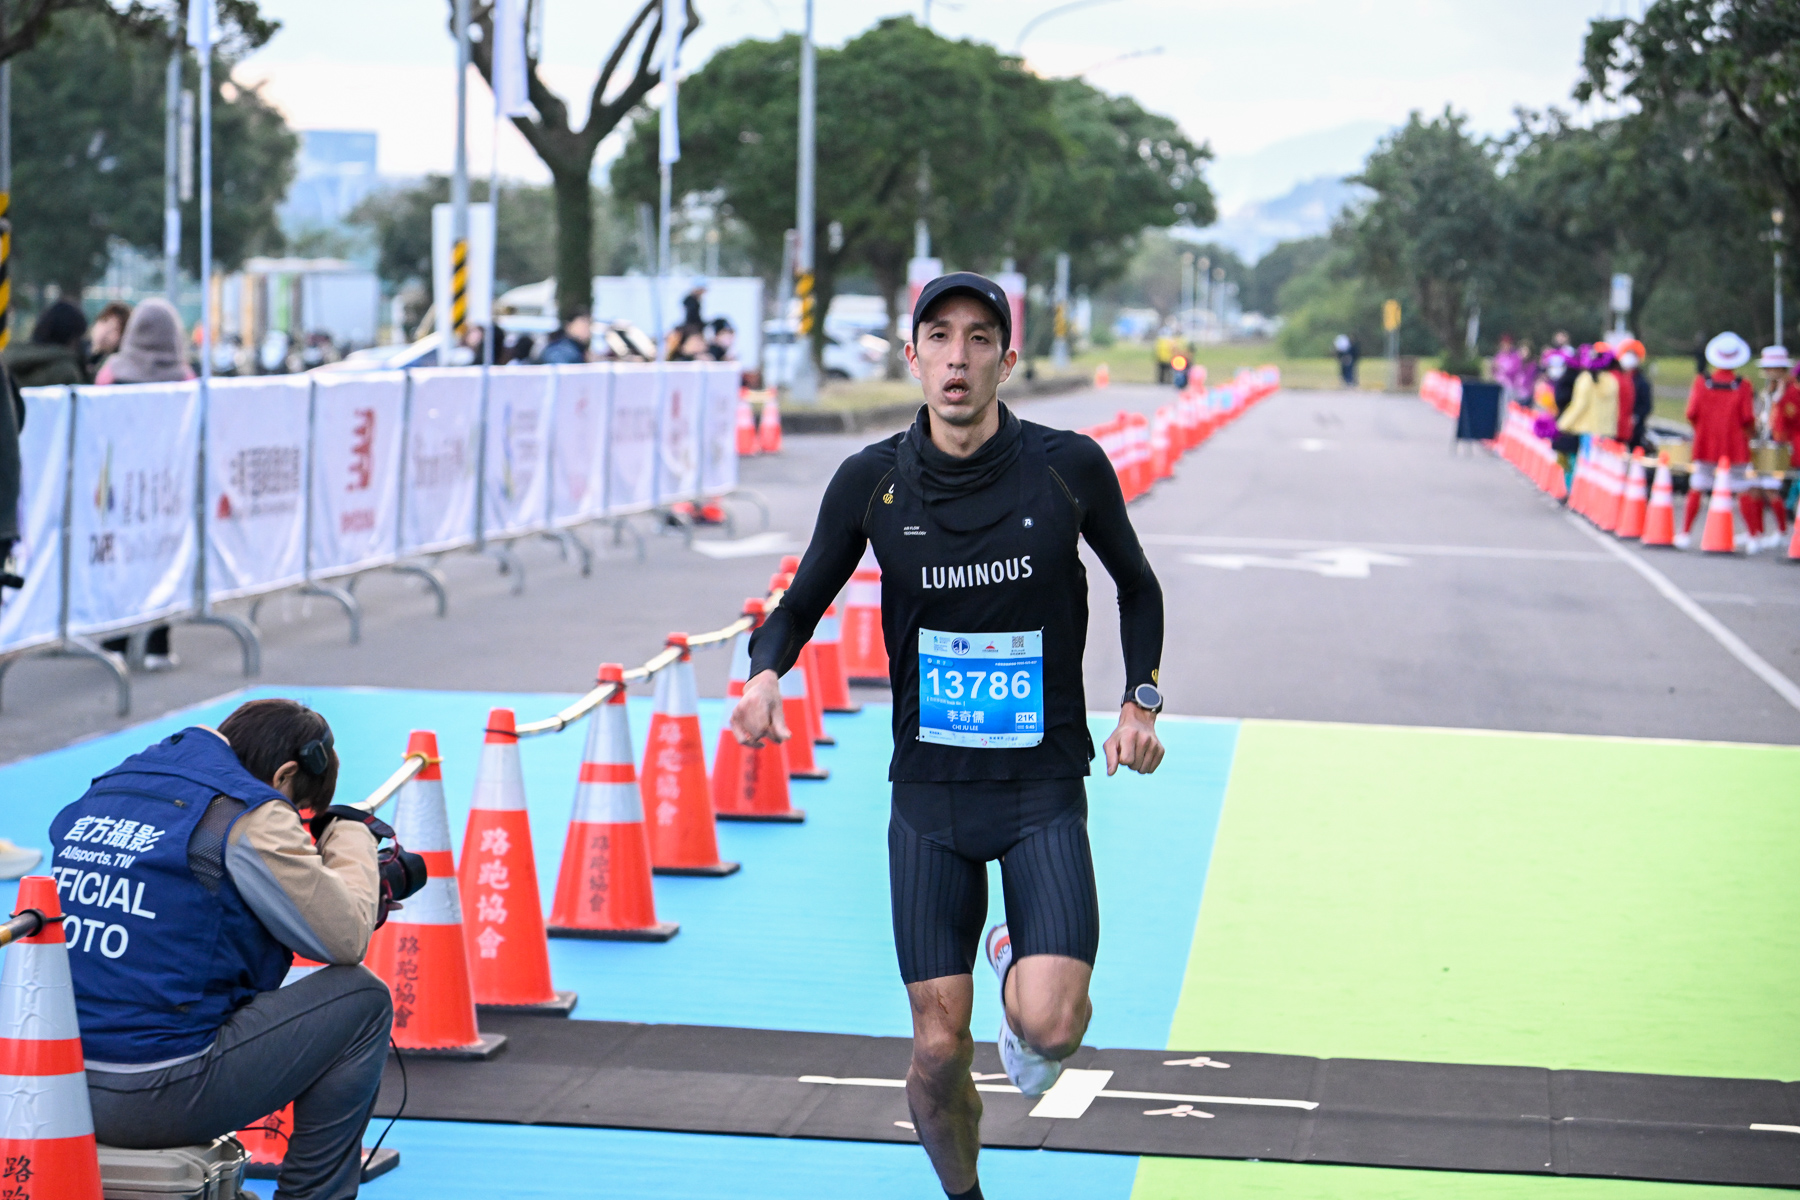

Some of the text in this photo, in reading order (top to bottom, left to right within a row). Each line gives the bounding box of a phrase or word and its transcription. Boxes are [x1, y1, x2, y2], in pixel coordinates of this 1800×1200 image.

[921, 555, 1033, 589] LUMINOUS
[926, 667, 1031, 700] 13786
[952, 723, 962, 731] CHI
[1017, 713, 1035, 722] 21K
[63, 815, 166, 853] 官方攝影
[475, 827, 512, 960] 路跑協會
[395, 935, 420, 1028] 路跑協會
